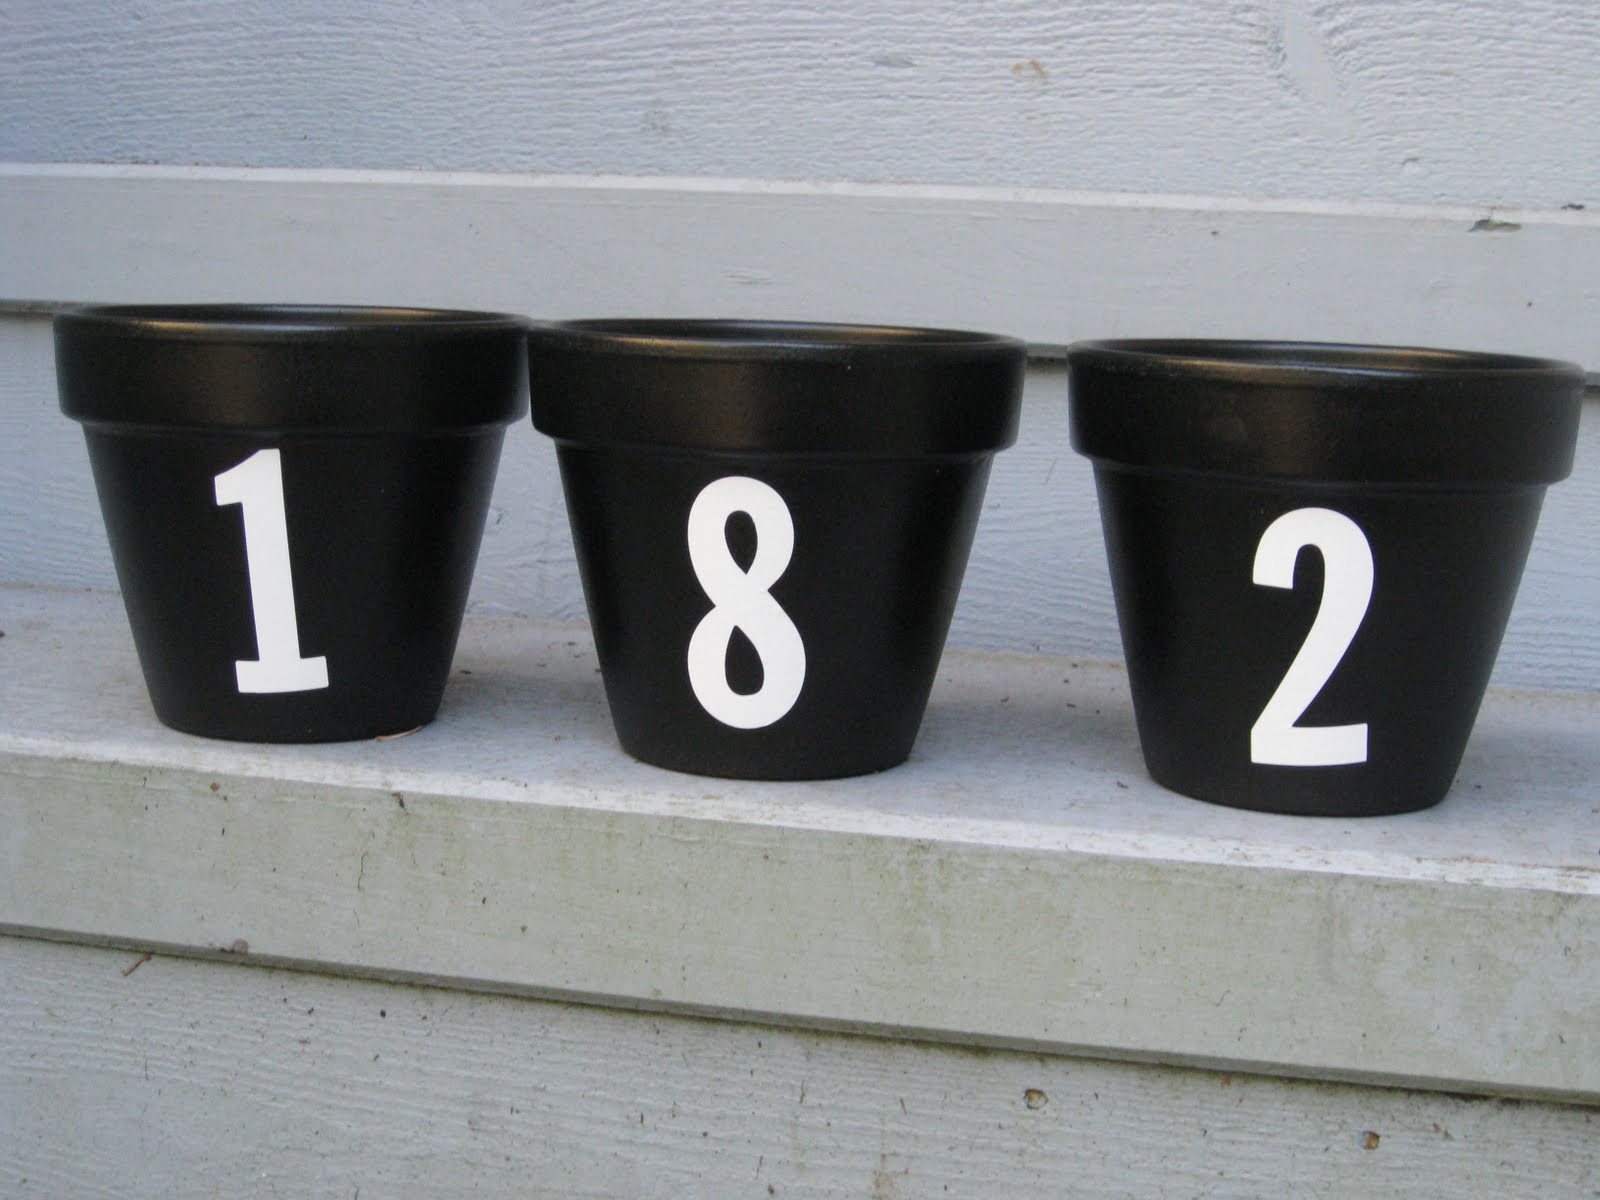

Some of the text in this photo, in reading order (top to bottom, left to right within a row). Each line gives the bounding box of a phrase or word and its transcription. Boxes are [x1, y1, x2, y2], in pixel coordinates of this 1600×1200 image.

[214, 448, 329, 694] 1
[687, 476, 807, 730] 8
[1250, 507, 1375, 767] 2
